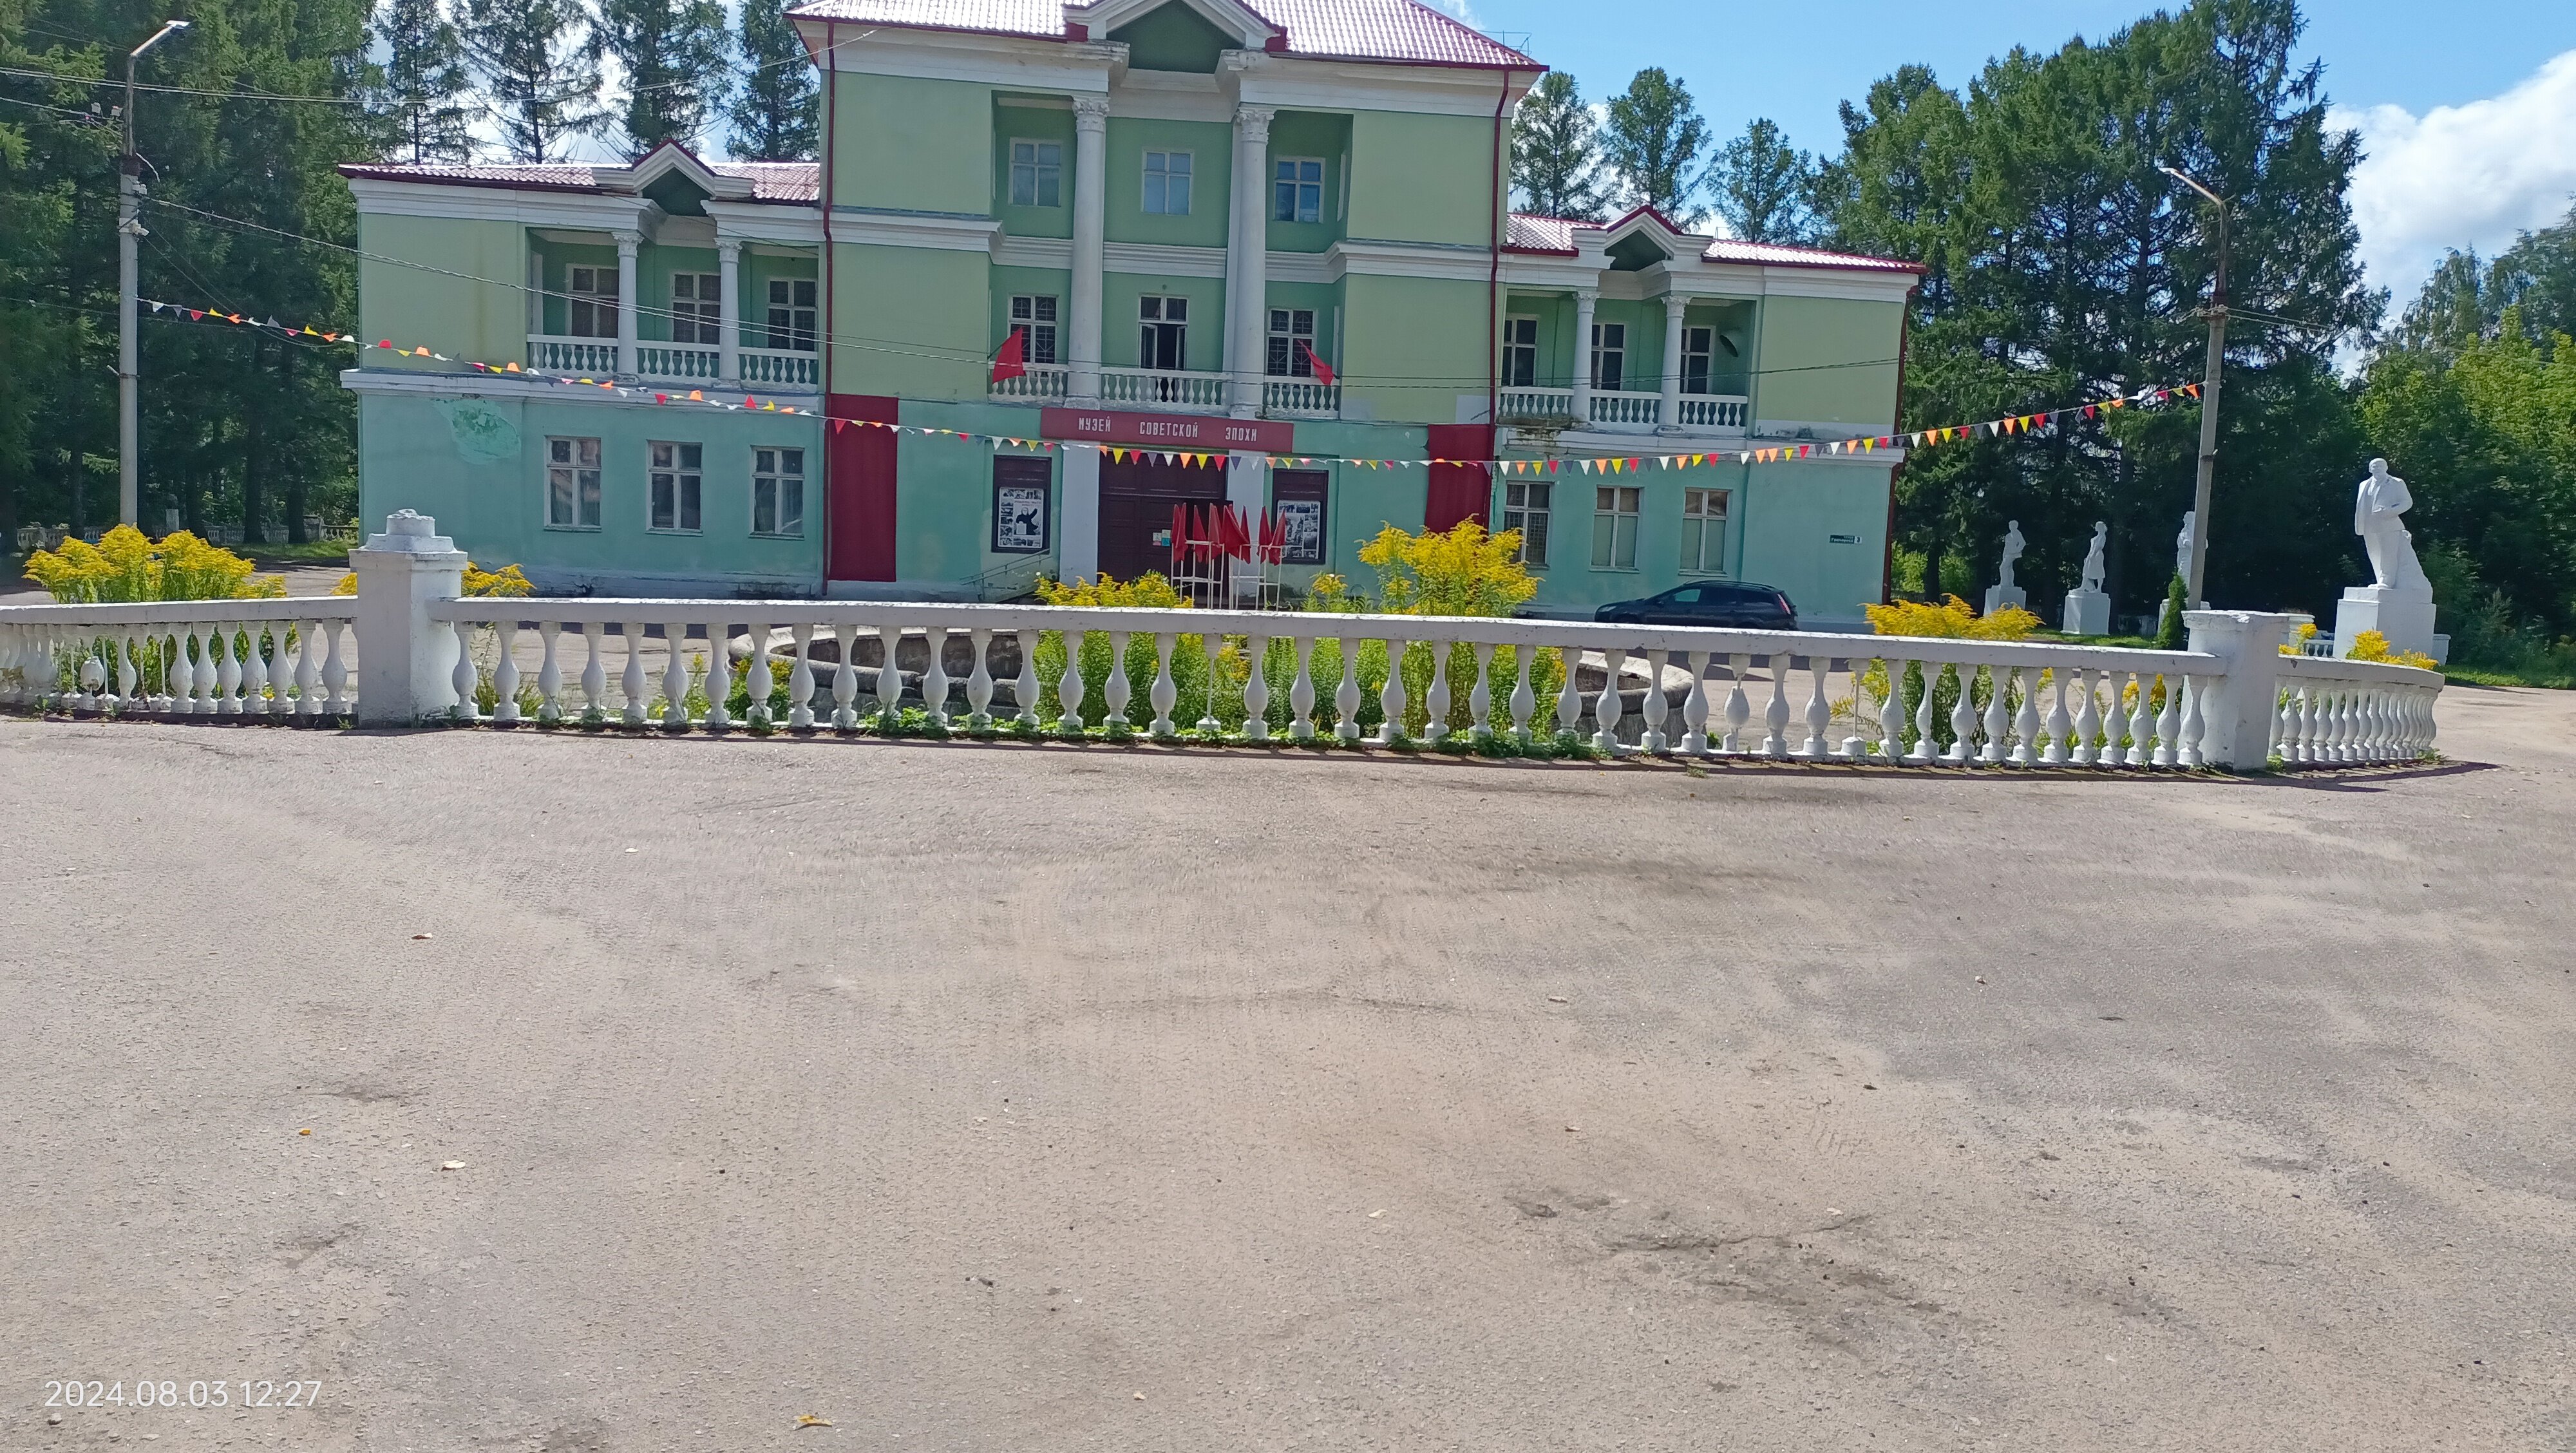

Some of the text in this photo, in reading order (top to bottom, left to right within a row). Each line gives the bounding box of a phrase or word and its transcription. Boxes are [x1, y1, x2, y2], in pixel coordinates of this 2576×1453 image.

[1079, 416, 1257, 442] МУЗЕЙ СОВЕТСКОЙ ЭПОХИ
